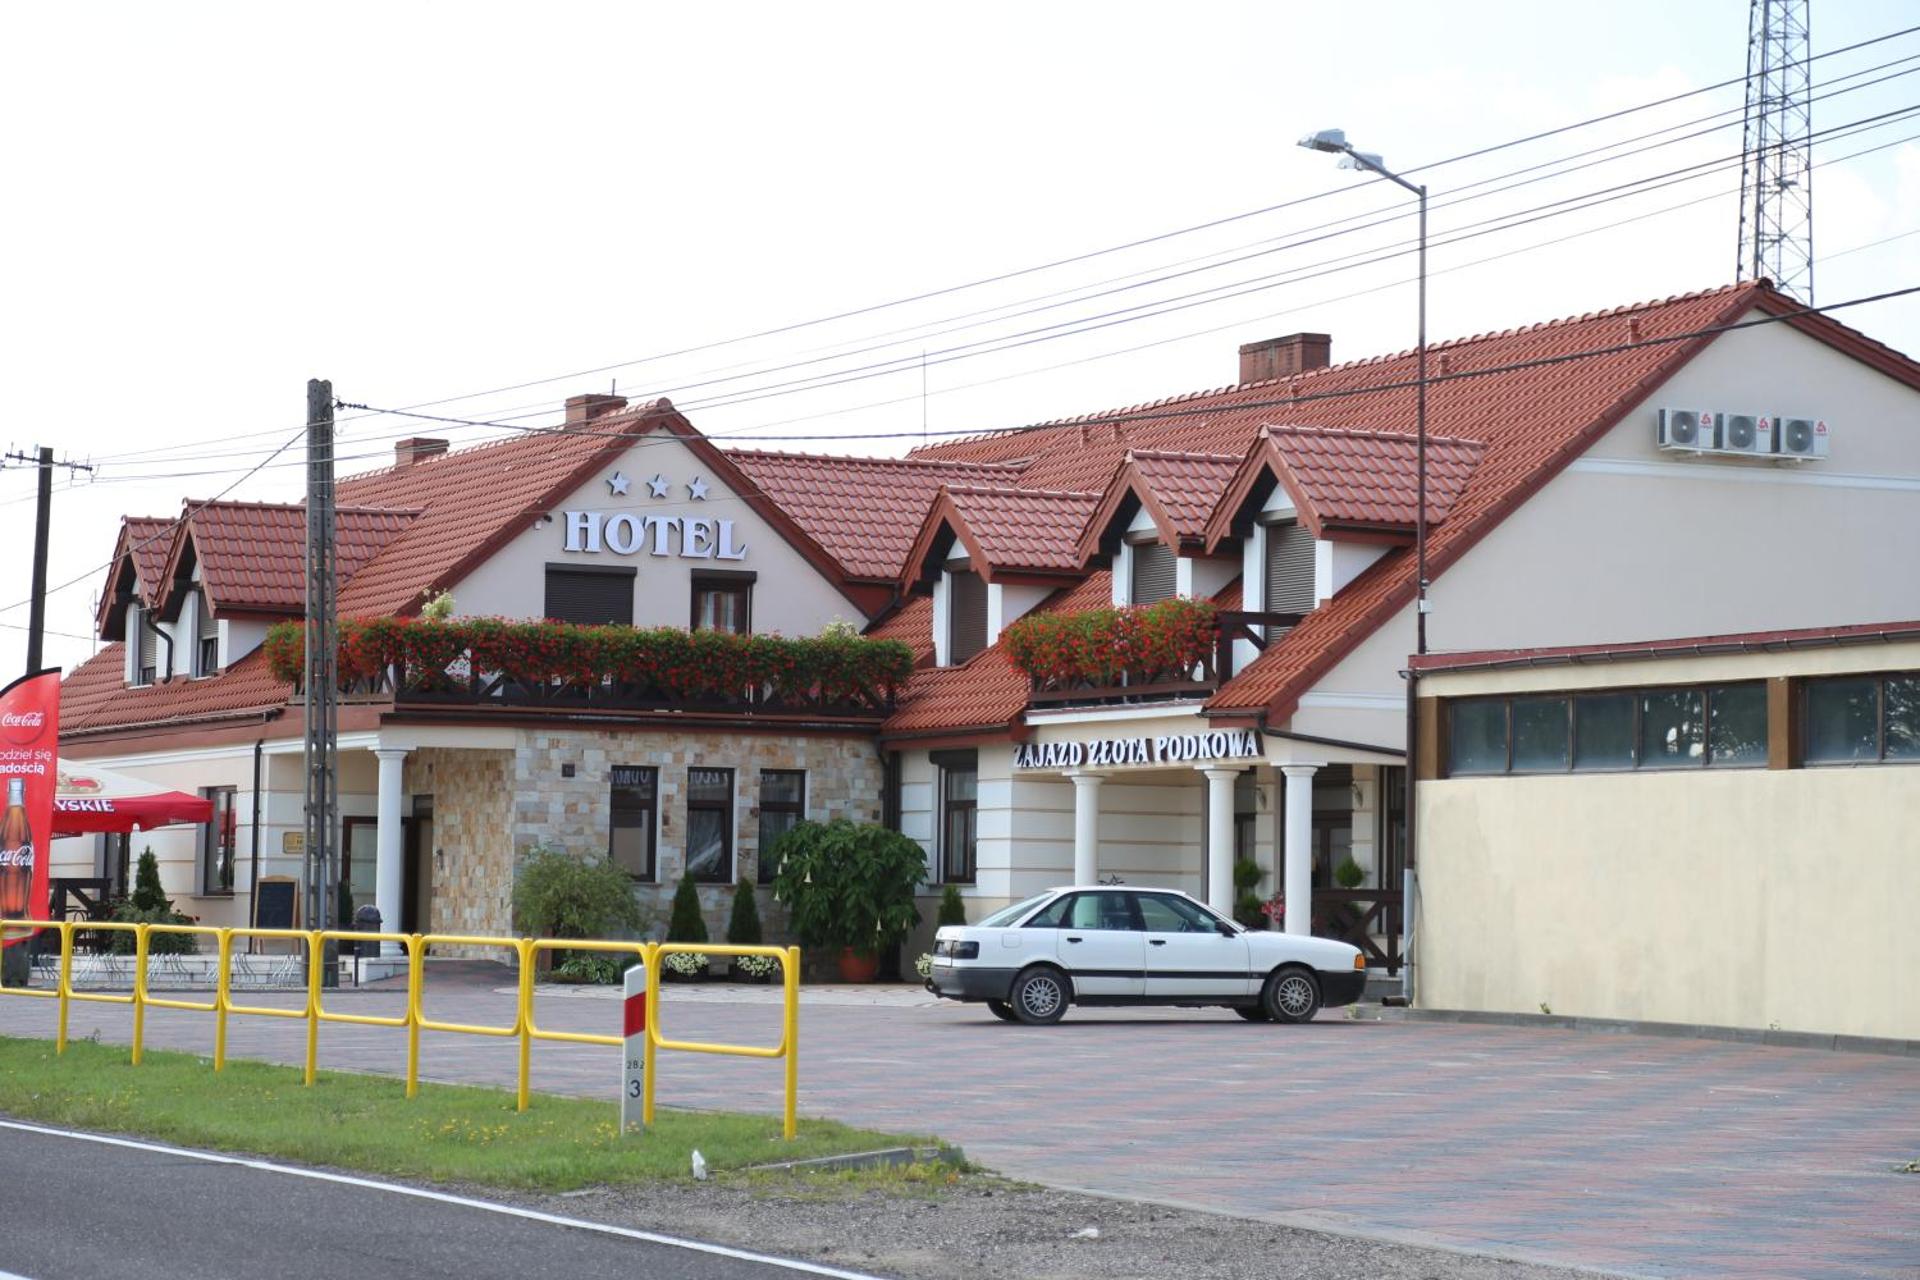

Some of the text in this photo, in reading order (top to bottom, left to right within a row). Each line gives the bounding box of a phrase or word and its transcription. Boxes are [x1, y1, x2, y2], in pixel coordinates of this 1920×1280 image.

[563, 511, 746, 560] HOTEL
[2, 712, 44, 726] Coca-Cola
[0, 748, 52, 762] odziel się
[1014, 729, 1260, 768] ZAJAZD ZŁOTA PODKOWA
[0, 761, 44, 775] adością
[53, 799, 115, 812] YSKIE
[629, 1079, 641, 1098] 3
